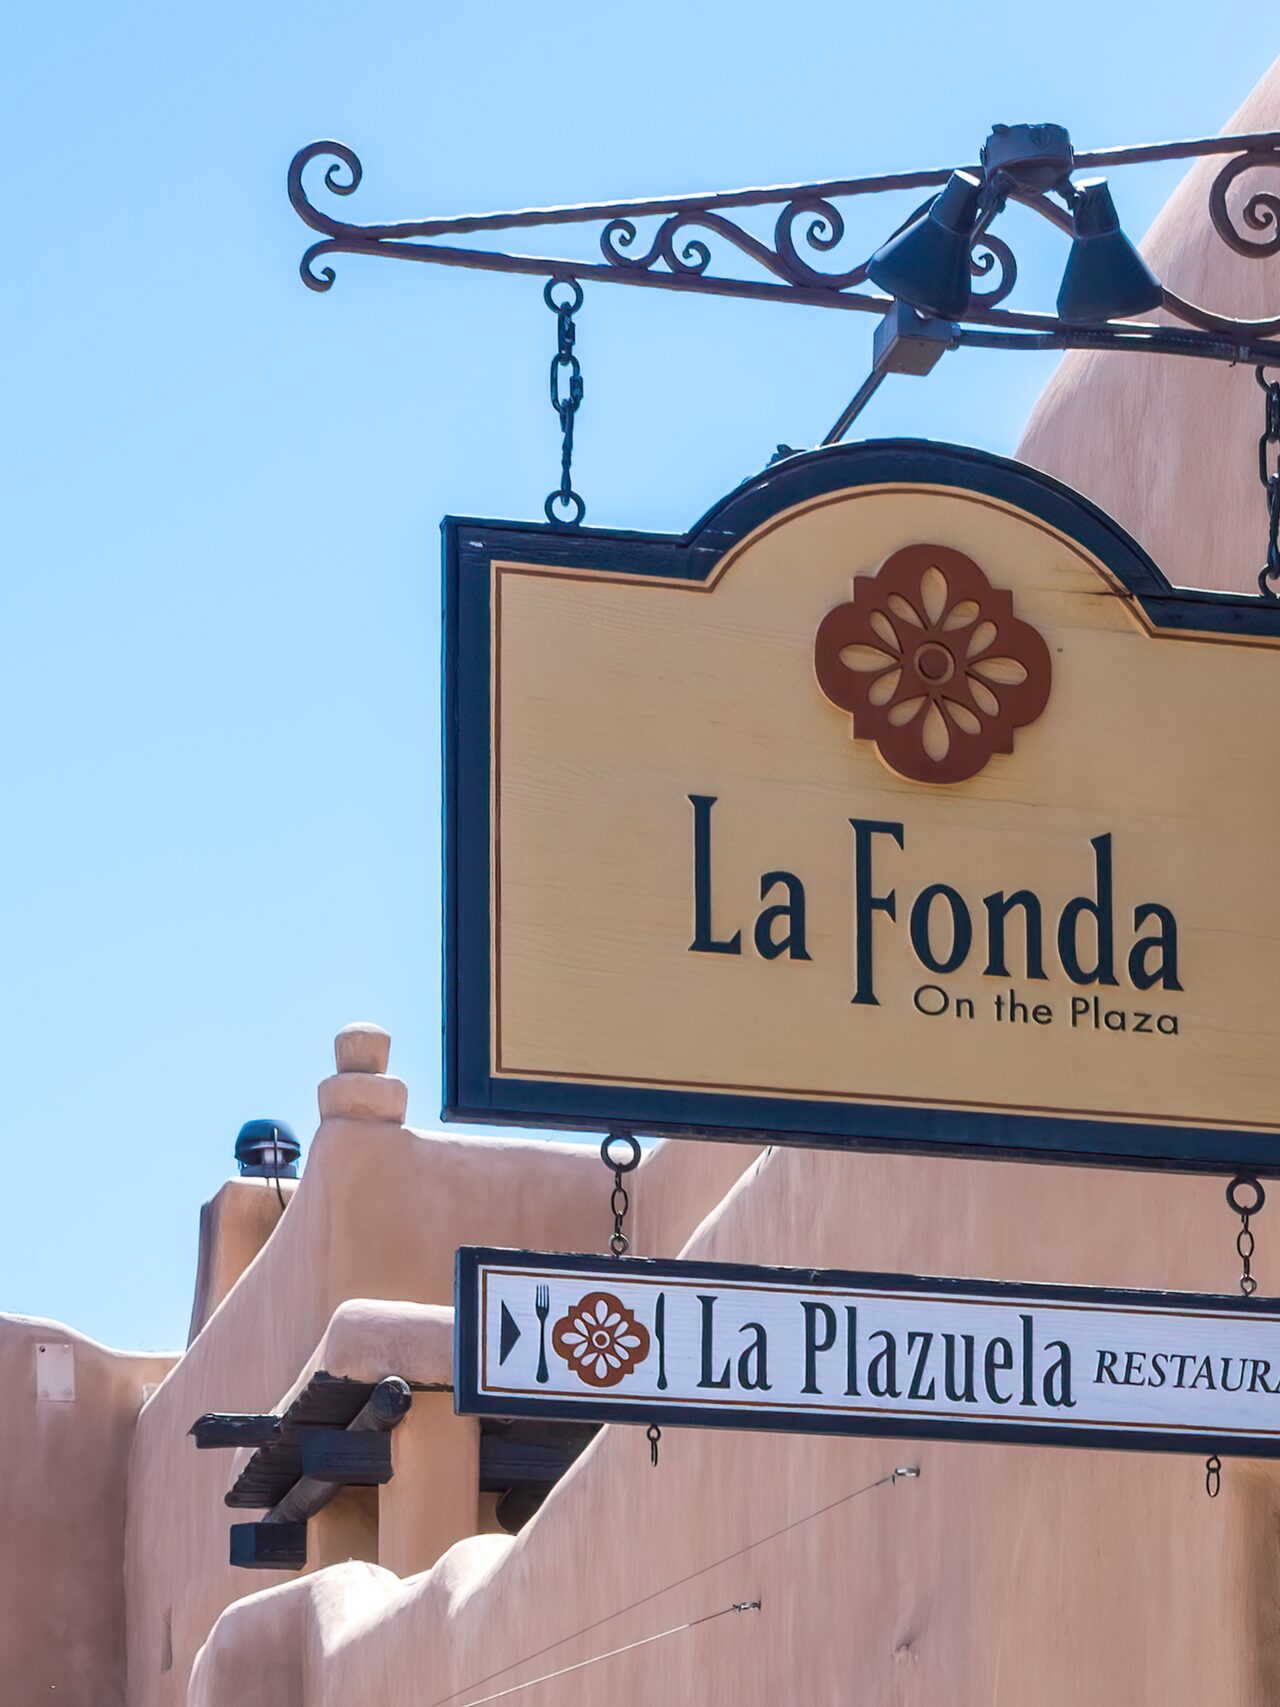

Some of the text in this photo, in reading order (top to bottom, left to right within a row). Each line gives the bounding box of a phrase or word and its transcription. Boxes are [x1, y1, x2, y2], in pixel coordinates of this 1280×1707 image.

[687, 794, 1185, 1007] La Fonda
[913, 984, 1179, 1035] On the Plaza
[696, 1295, 772, 1391] La
[800, 1301, 1077, 1408] Plazuela
